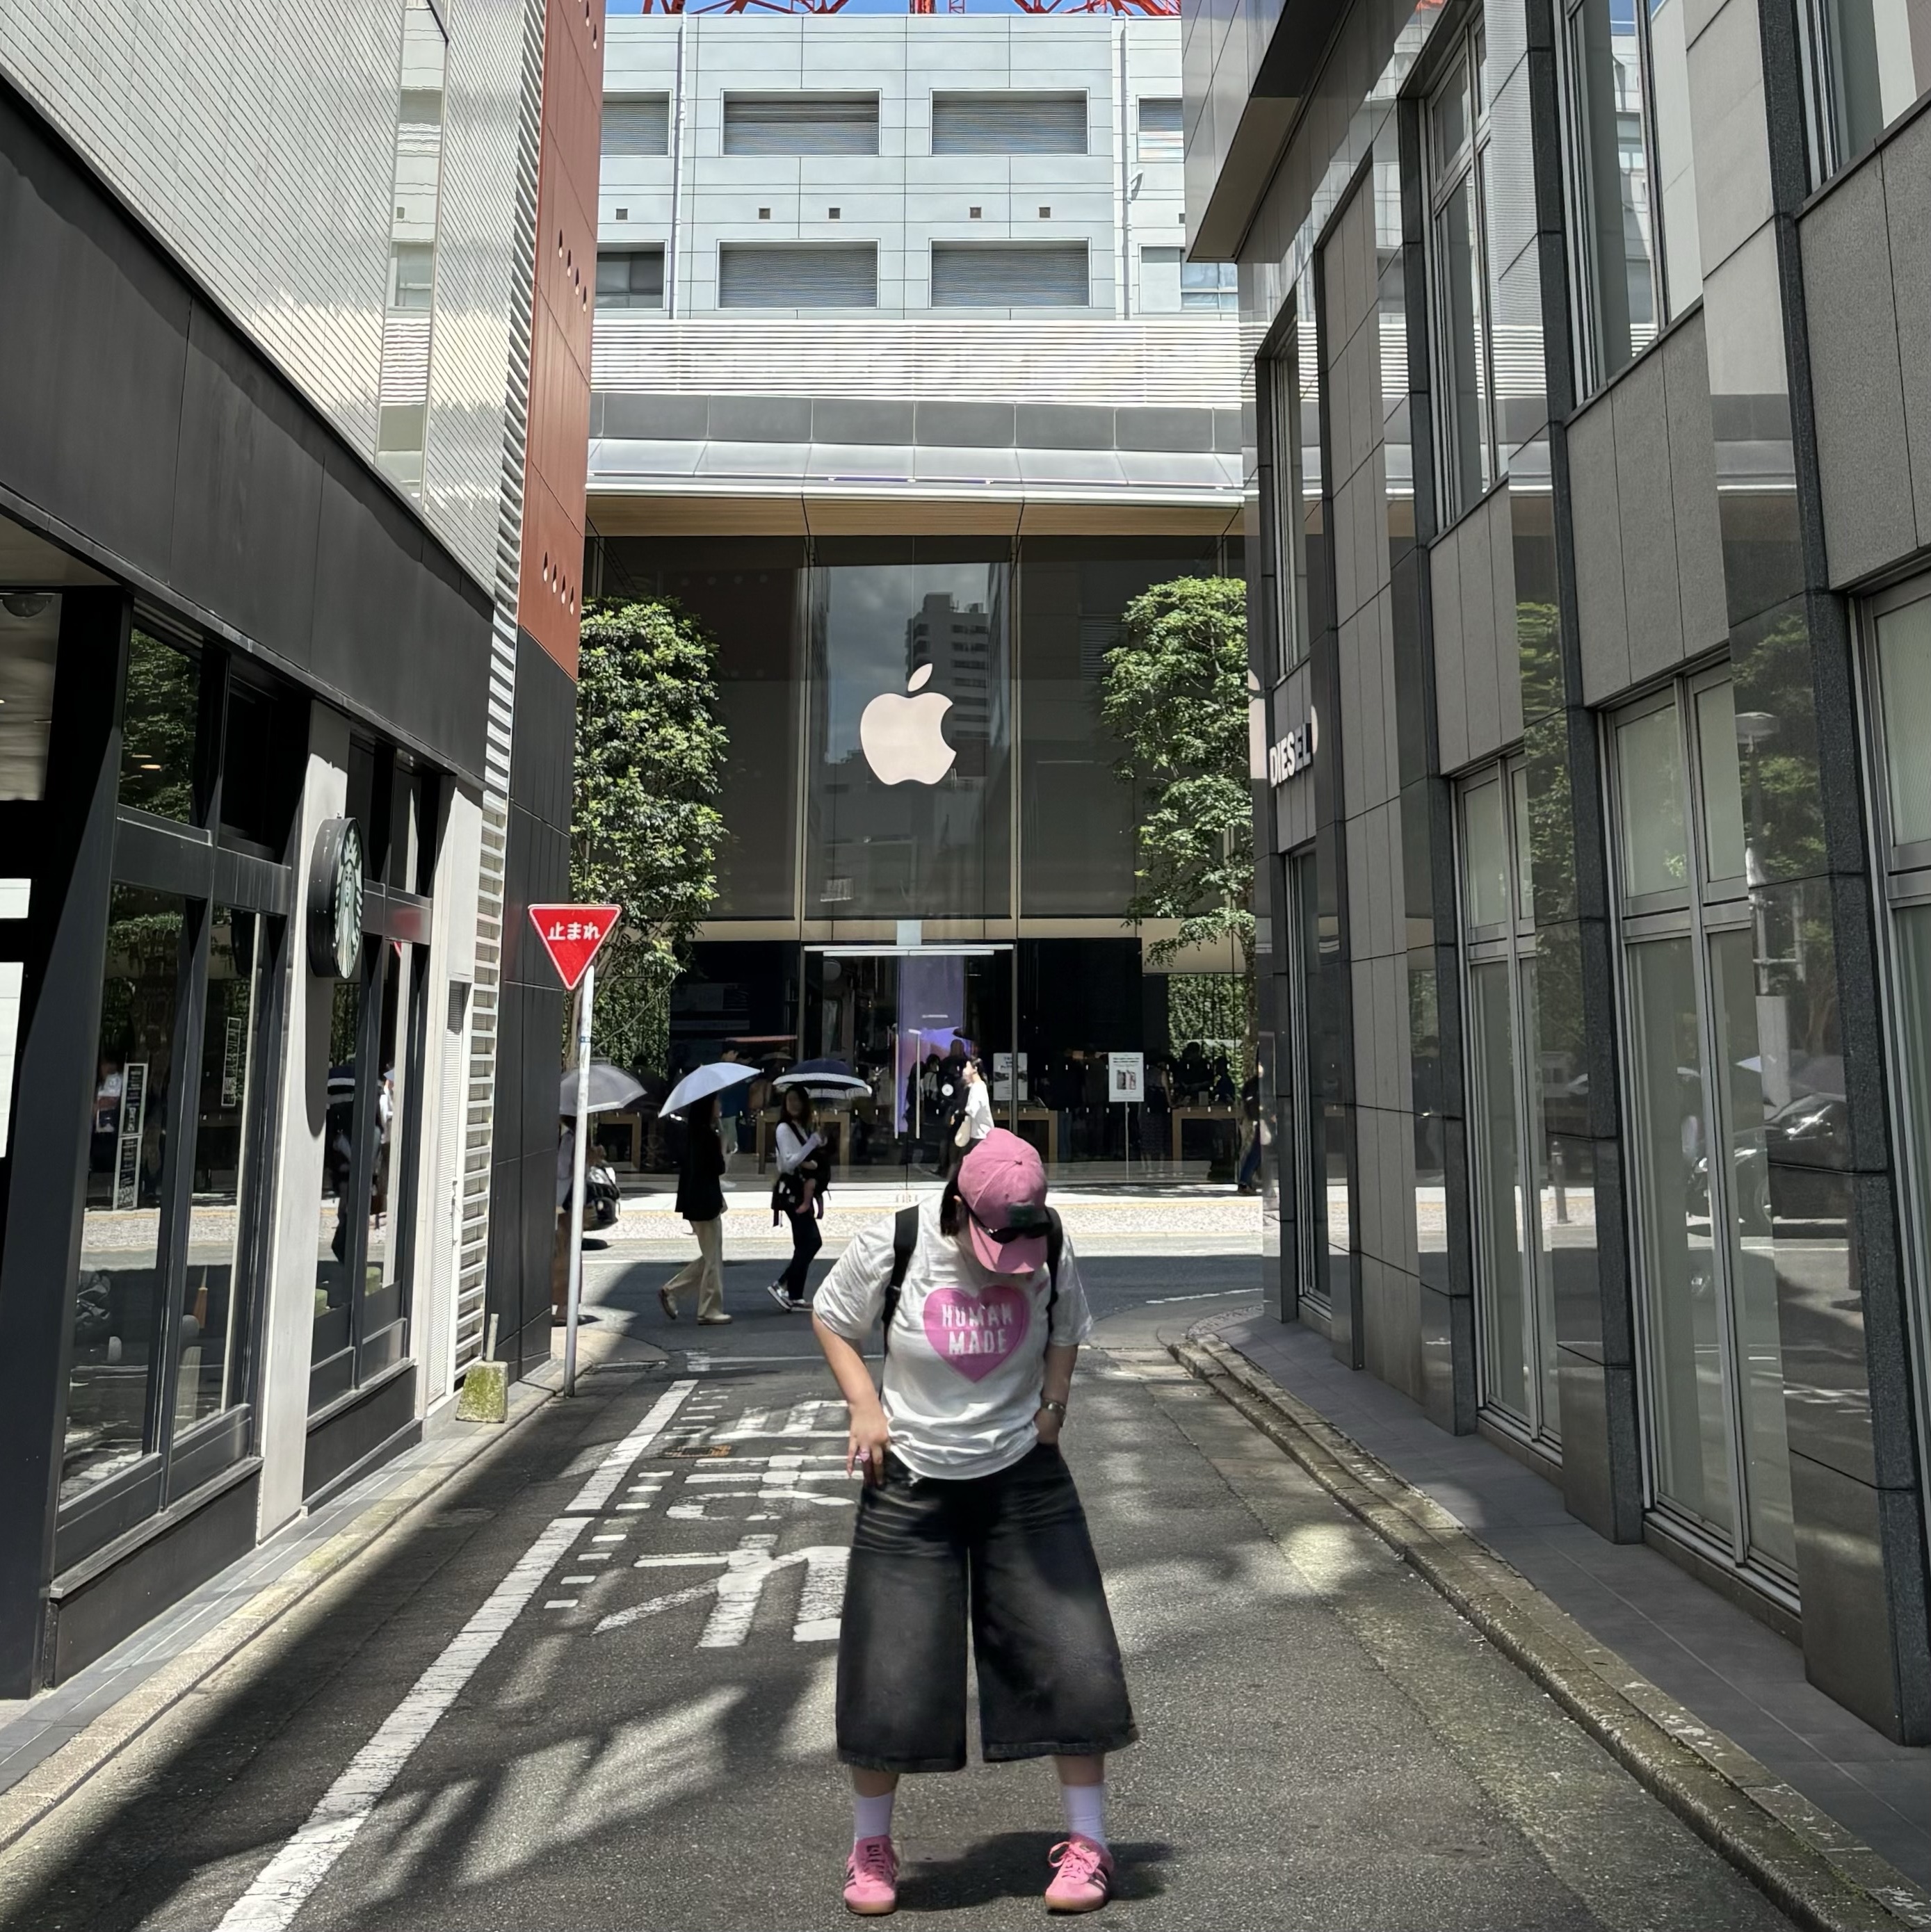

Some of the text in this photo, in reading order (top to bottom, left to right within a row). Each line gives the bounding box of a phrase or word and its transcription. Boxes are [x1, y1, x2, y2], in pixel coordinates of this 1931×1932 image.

[1269, 723, 1311, 788] DIESEL
[547, 921, 601, 941] 止まれ
[942, 1303, 1012, 1328] HUMAN
[949, 1329, 1007, 1355] MADE
